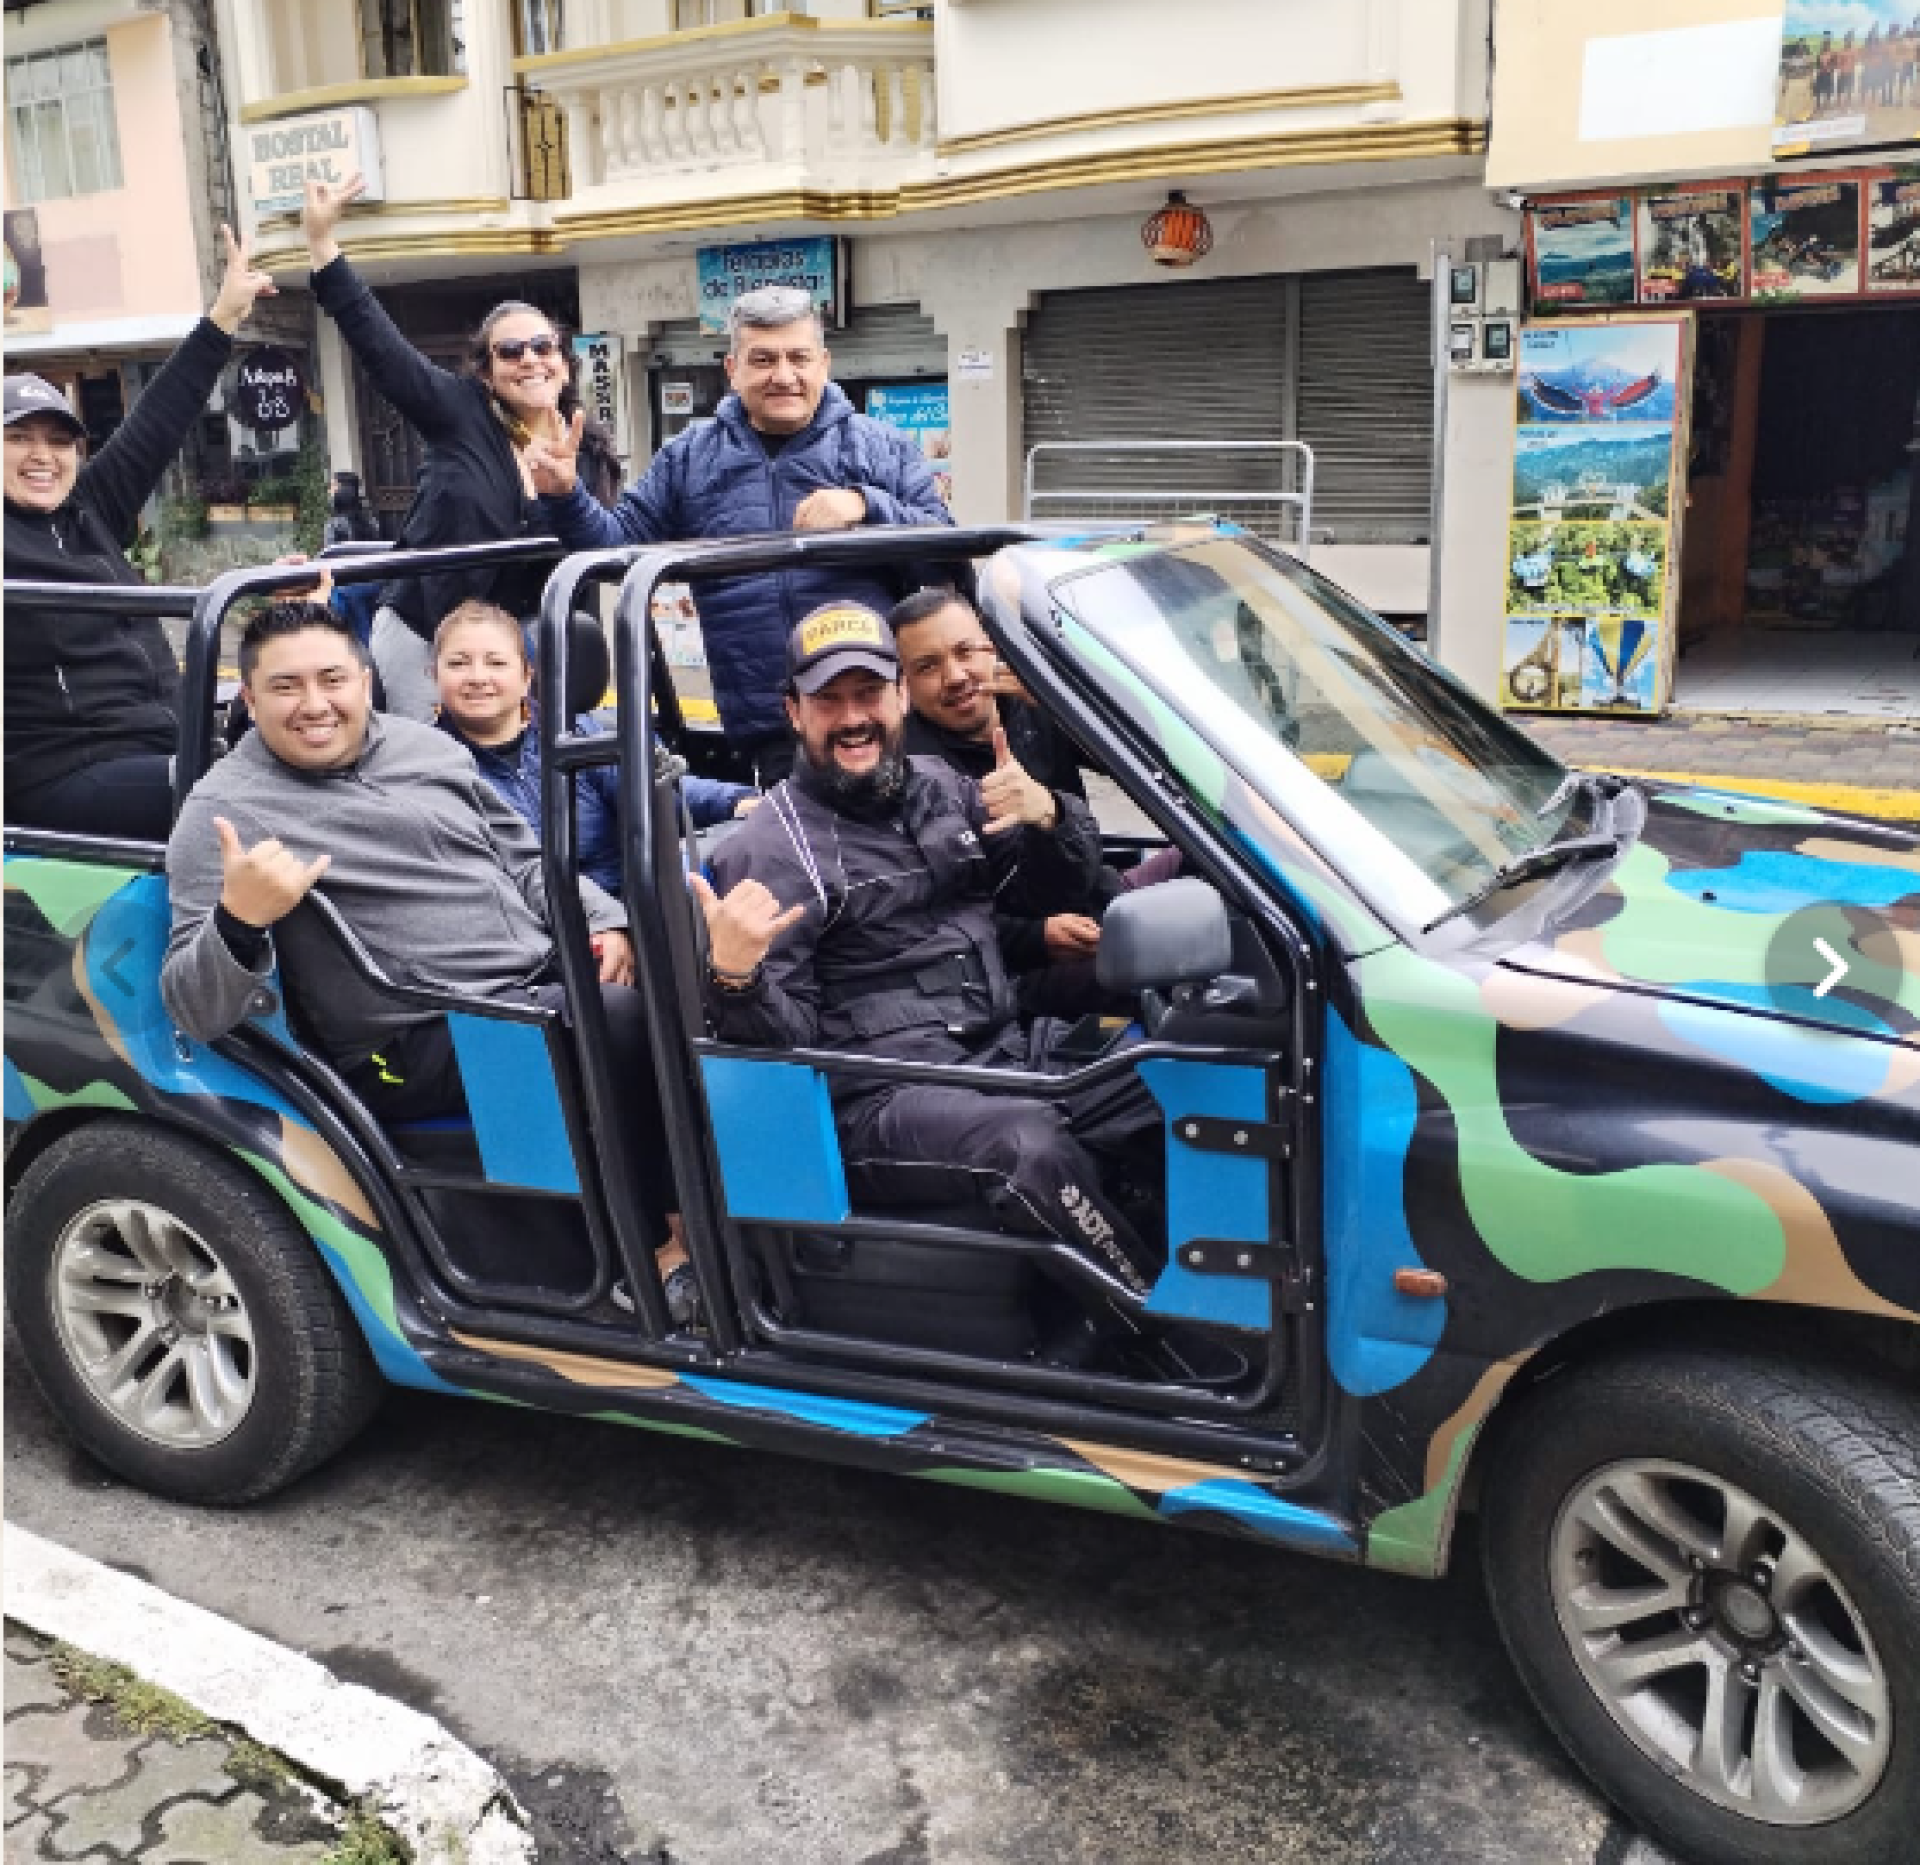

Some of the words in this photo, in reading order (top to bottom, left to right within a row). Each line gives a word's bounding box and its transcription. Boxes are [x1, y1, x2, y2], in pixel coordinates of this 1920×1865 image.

[252, 121, 348, 162] HOSTAL
[267, 159, 342, 193] REAL
[703, 279, 728, 300] de
